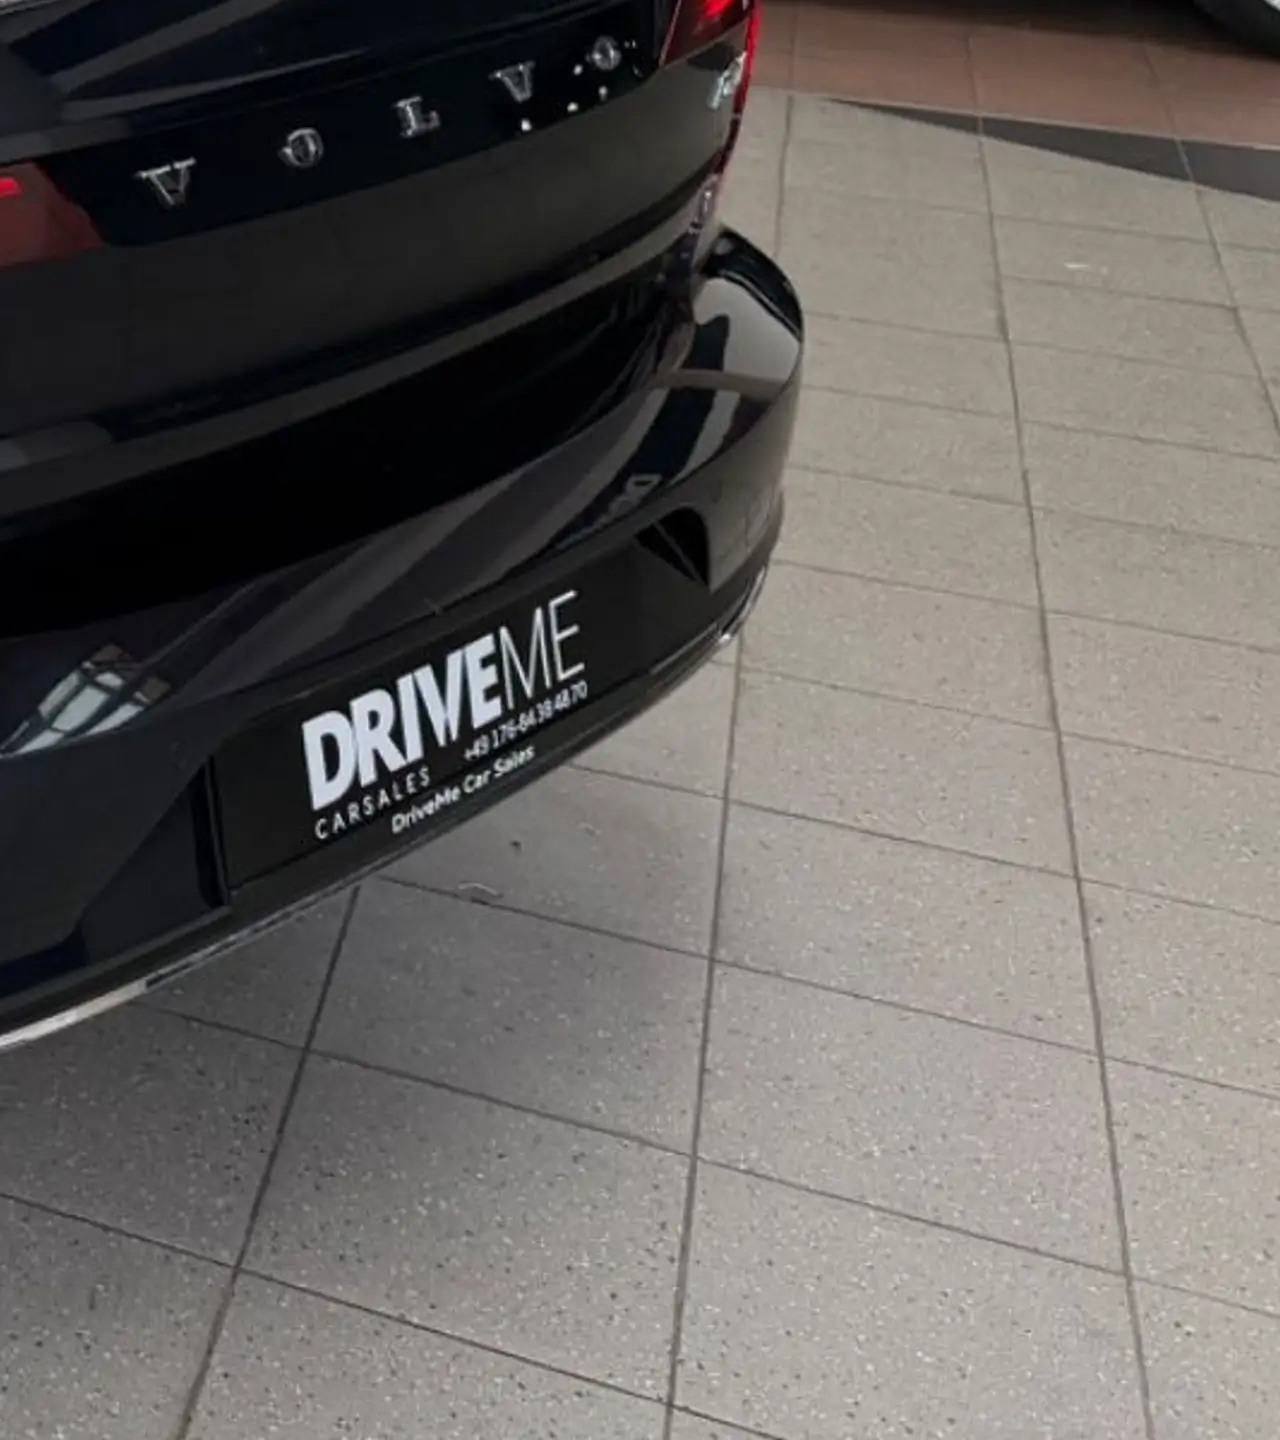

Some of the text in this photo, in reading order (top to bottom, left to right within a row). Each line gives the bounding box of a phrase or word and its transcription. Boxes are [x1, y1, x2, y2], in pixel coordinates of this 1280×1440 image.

[136, 36, 622, 207] VOLVO
[314, 765, 431, 840] CARSALES
[463, 768, 492, 794] Car
[493, 745, 536, 778] Sales
